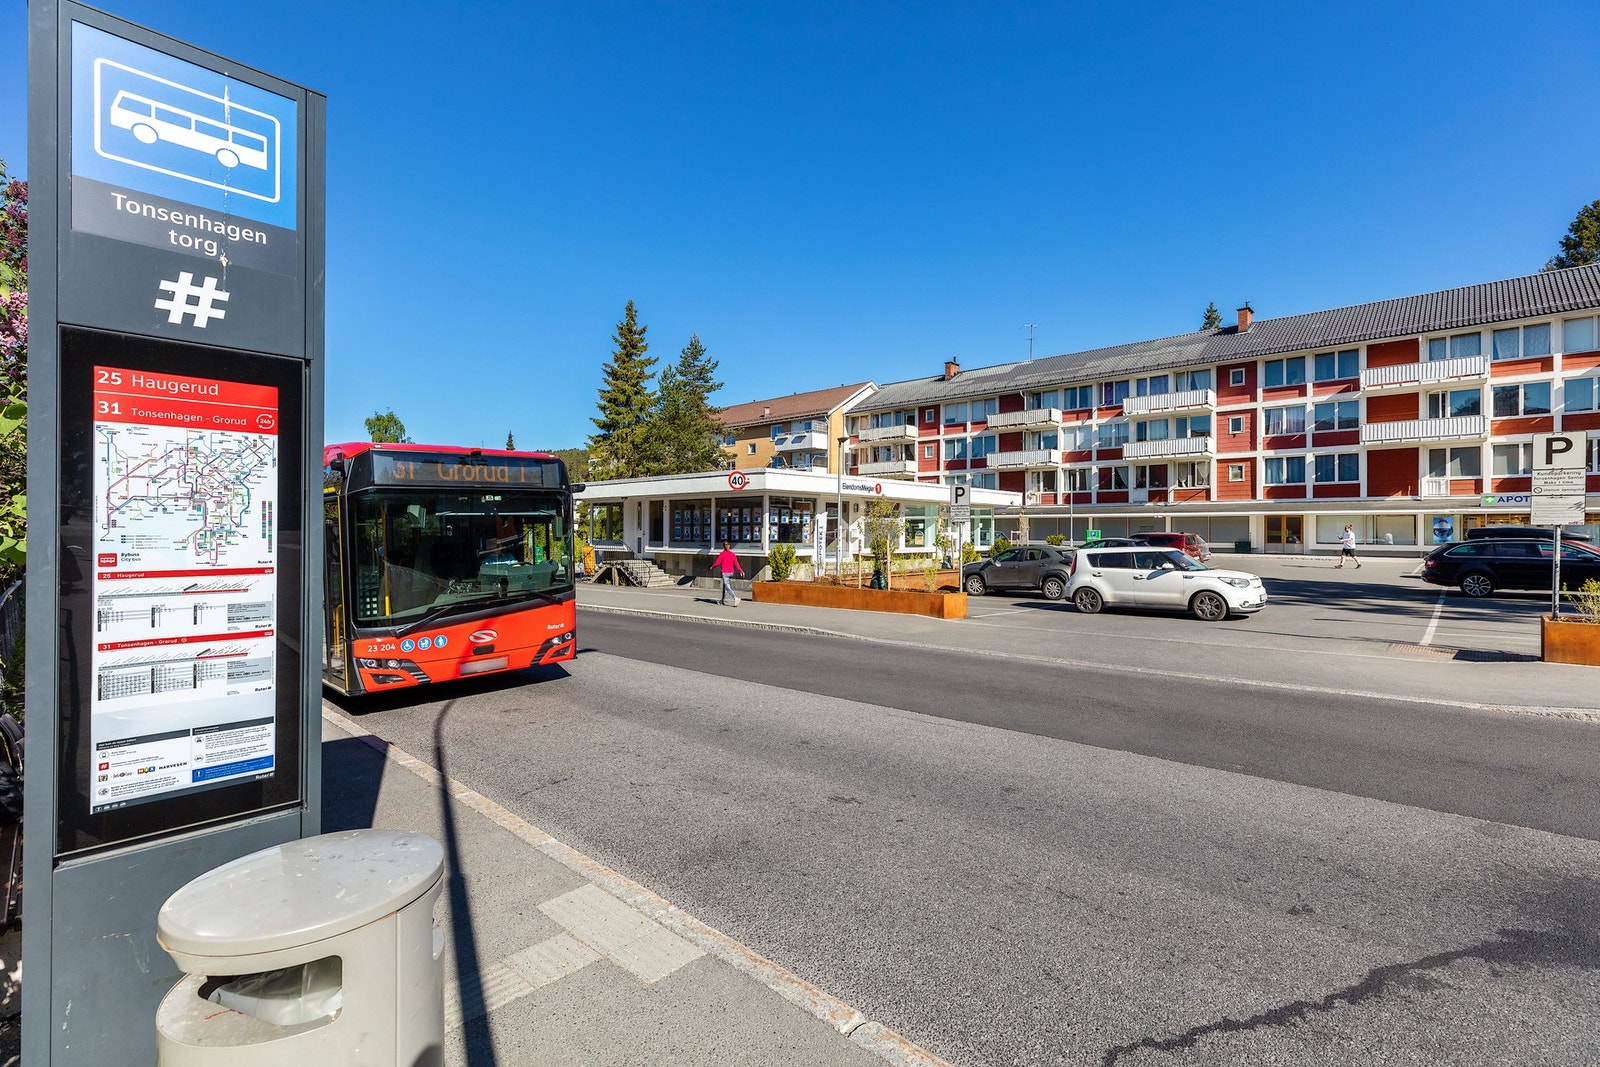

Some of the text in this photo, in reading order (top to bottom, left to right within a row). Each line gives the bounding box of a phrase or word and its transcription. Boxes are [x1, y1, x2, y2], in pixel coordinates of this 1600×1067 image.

[110, 192, 267, 245] Tonsenhagen
[168, 229, 218, 256] torg
[97, 370, 219, 396] 25 Haugerud
[97, 401, 122, 415] 31
[131, 407, 203, 423] Tonsenhagen
[212, 415, 247, 426] Grorud
[259, 416, 272, 425] 24h
[1546, 437, 1573, 465] P
[437, 461, 509, 482] Grorud
[731, 476, 744, 486] 40
[842, 482, 875, 494] EiendomsMegler
[955, 486, 966, 504] P
[116, 640, 154, 648] Tonsenhagen
[367, 643, 396, 653] 23 204
